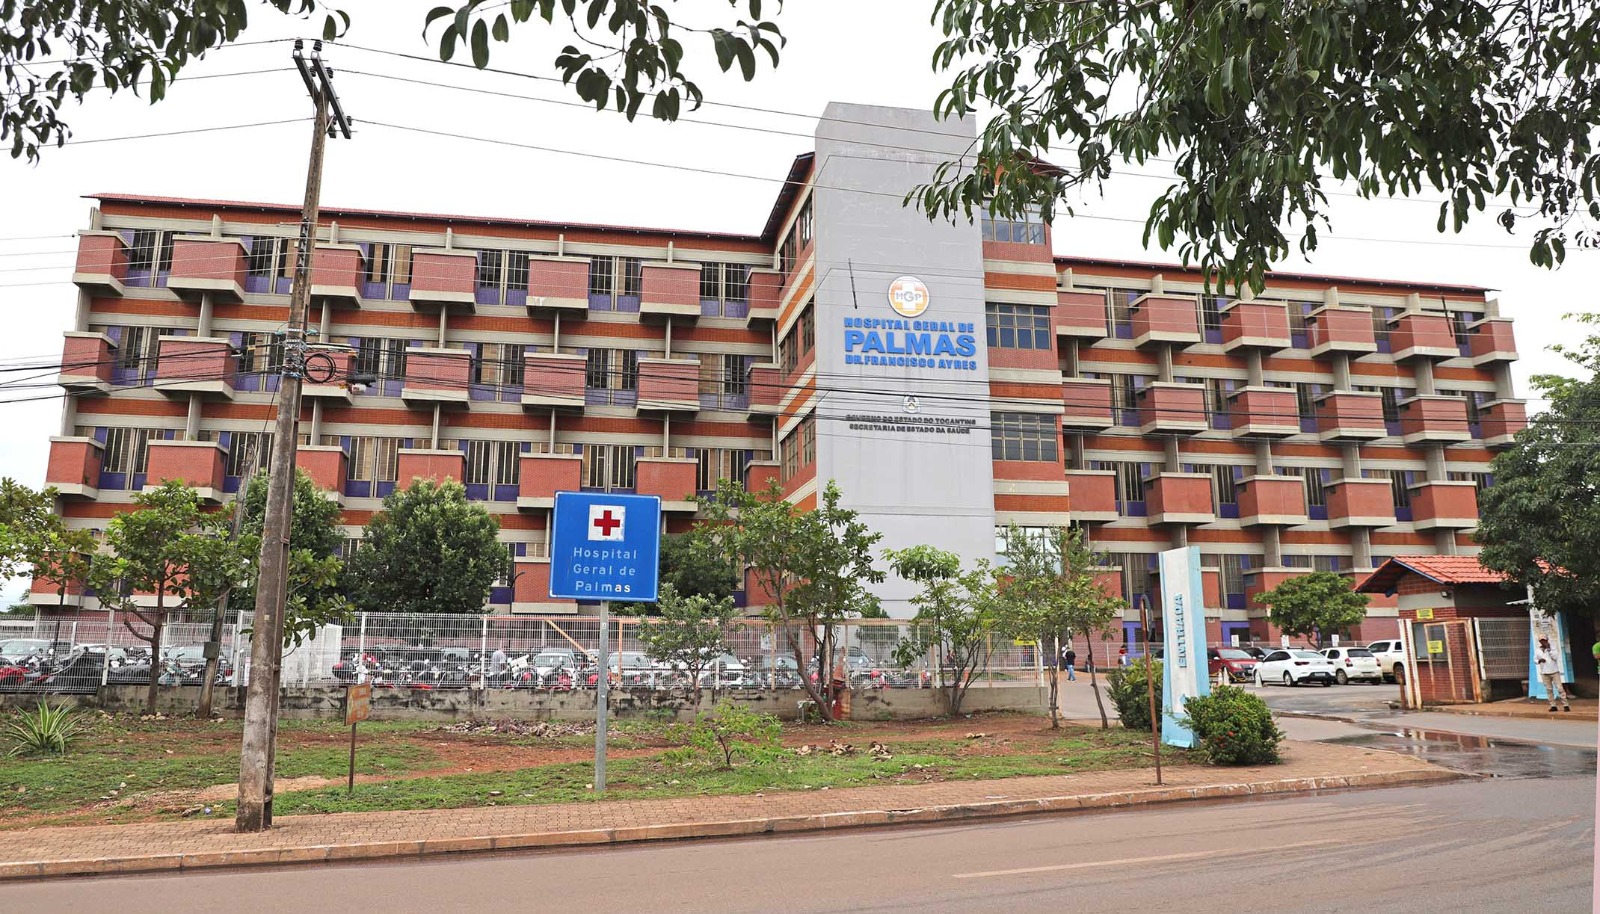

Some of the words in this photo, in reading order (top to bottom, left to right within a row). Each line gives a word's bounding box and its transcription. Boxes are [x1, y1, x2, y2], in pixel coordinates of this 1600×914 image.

[895, 291, 922, 302] HGP
[844, 317, 910, 330] HOSPITAL
[913, 320, 956, 332] GERAL
[958, 323, 975, 333] DE
[844, 331, 976, 357] PALMAS
[938, 359, 977, 371] AYRES
[894, 416, 923, 424] ESTADO
[849, 423, 896, 432] SECRETARIA
[573, 547, 637, 560] Hospital
[573, 564, 613, 575] Geral
[619, 566, 636, 576] de
[575, 581, 631, 593] Palmas
[1174, 593, 1187, 667] ENTRADA
